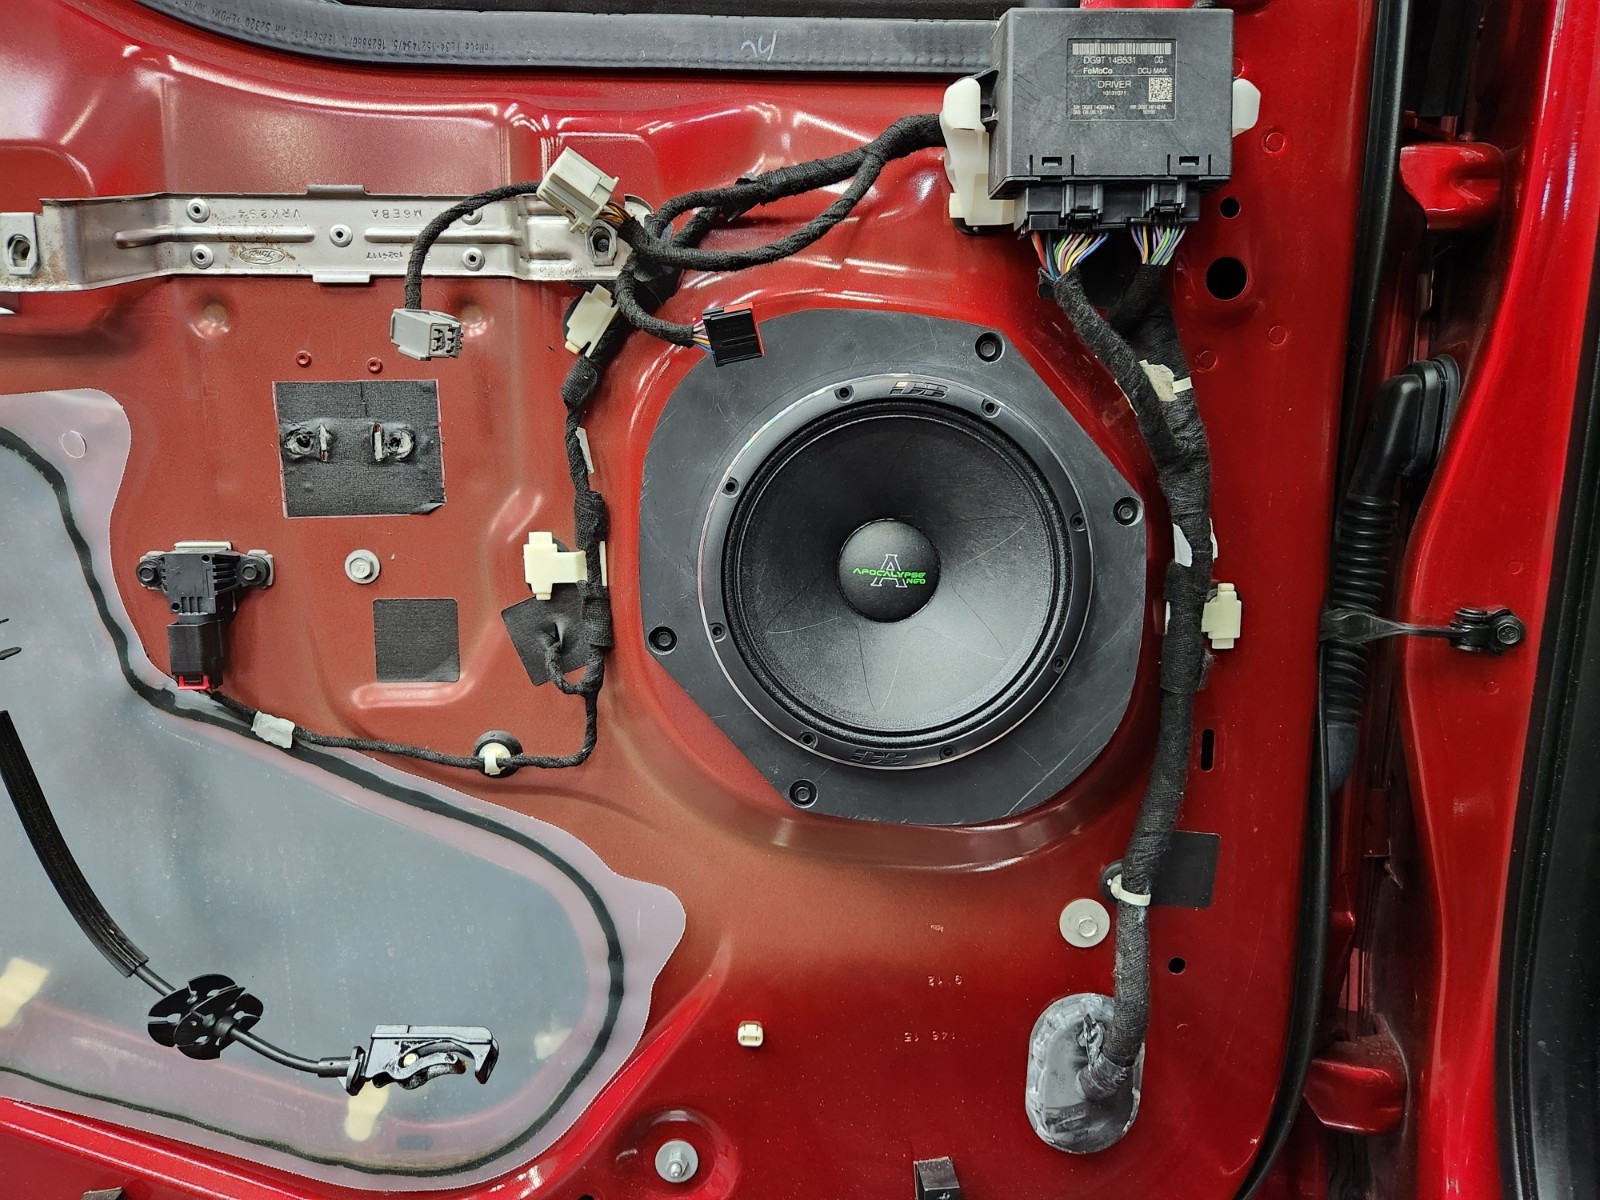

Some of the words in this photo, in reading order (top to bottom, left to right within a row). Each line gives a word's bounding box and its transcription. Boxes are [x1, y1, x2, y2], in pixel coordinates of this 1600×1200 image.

[1083, 56, 1106, 64] DG9T
[1083, 67, 1113, 75] FoMoCo
[1137, 67, 1152, 75] DCU
[1097, 80, 1132, 89] DRIVER
[247, 250, 276, 263] Ford
[852, 567, 927, 579] APOCALYPSE
